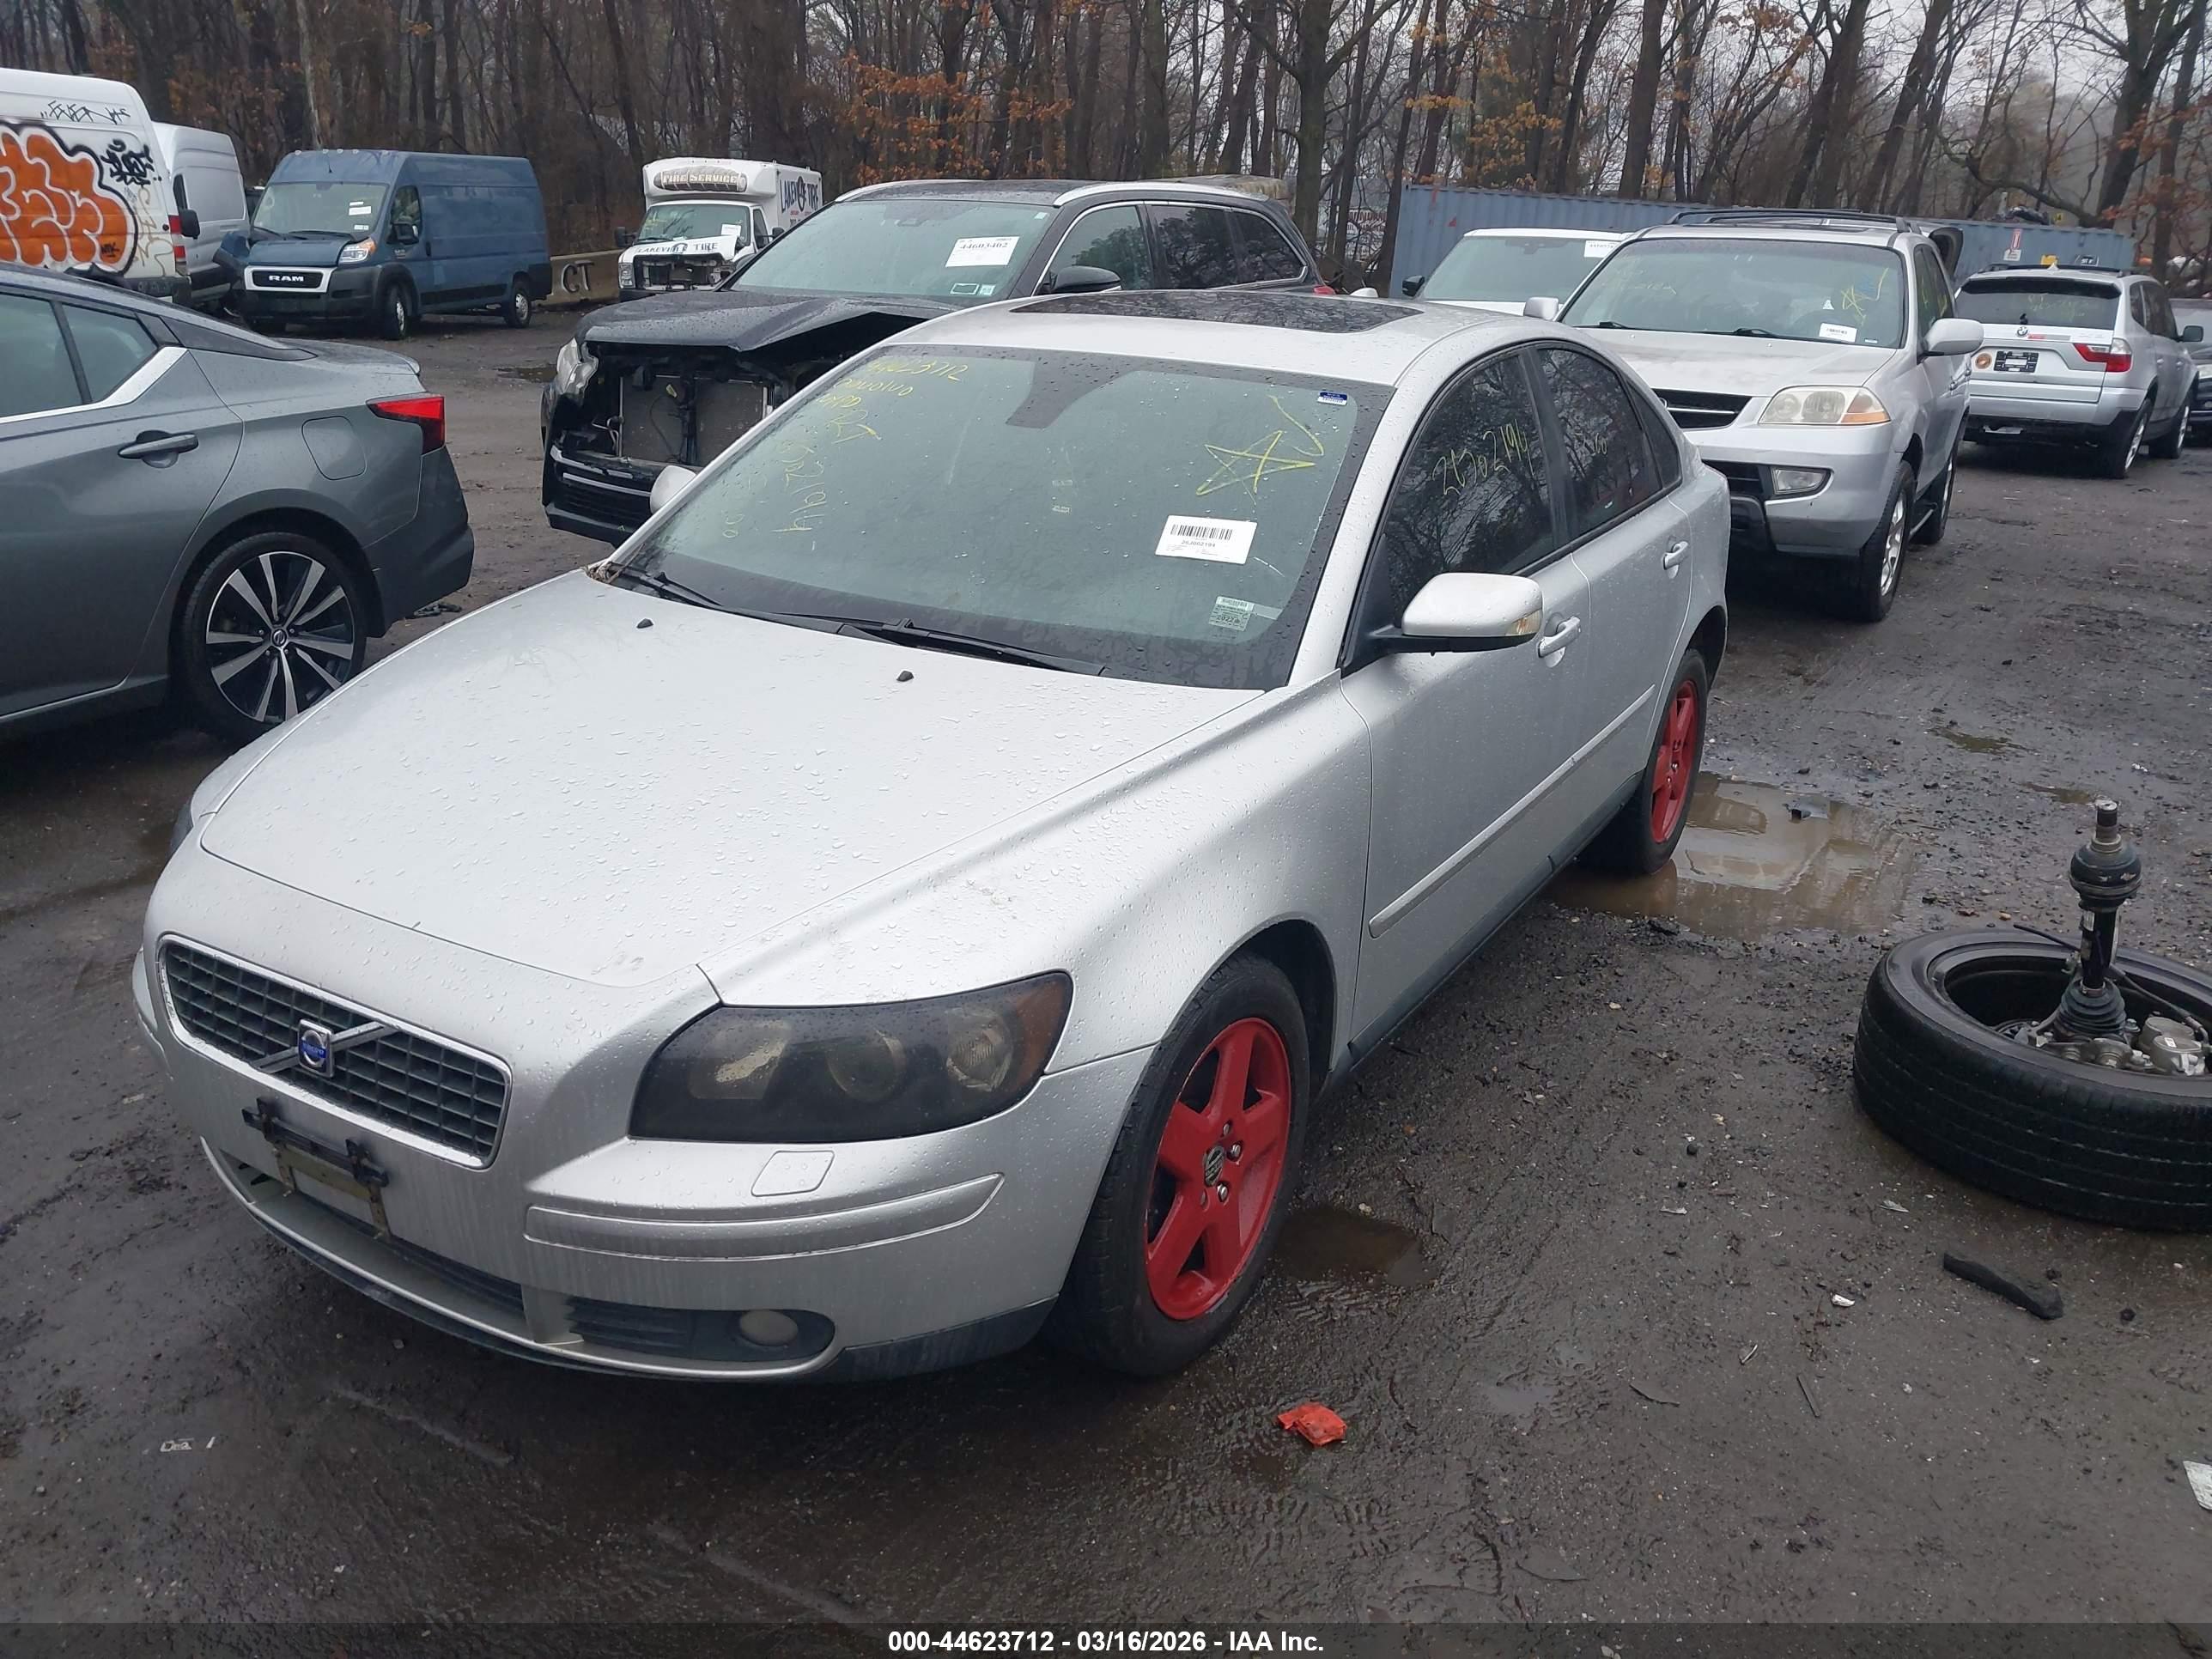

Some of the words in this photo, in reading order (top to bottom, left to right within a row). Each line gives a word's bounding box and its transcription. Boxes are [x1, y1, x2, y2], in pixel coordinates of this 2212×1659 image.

[663, 173, 687, 183] TIRE
[688, 173, 738, 183] SERVICE
[694, 242, 718, 251] TIRE
